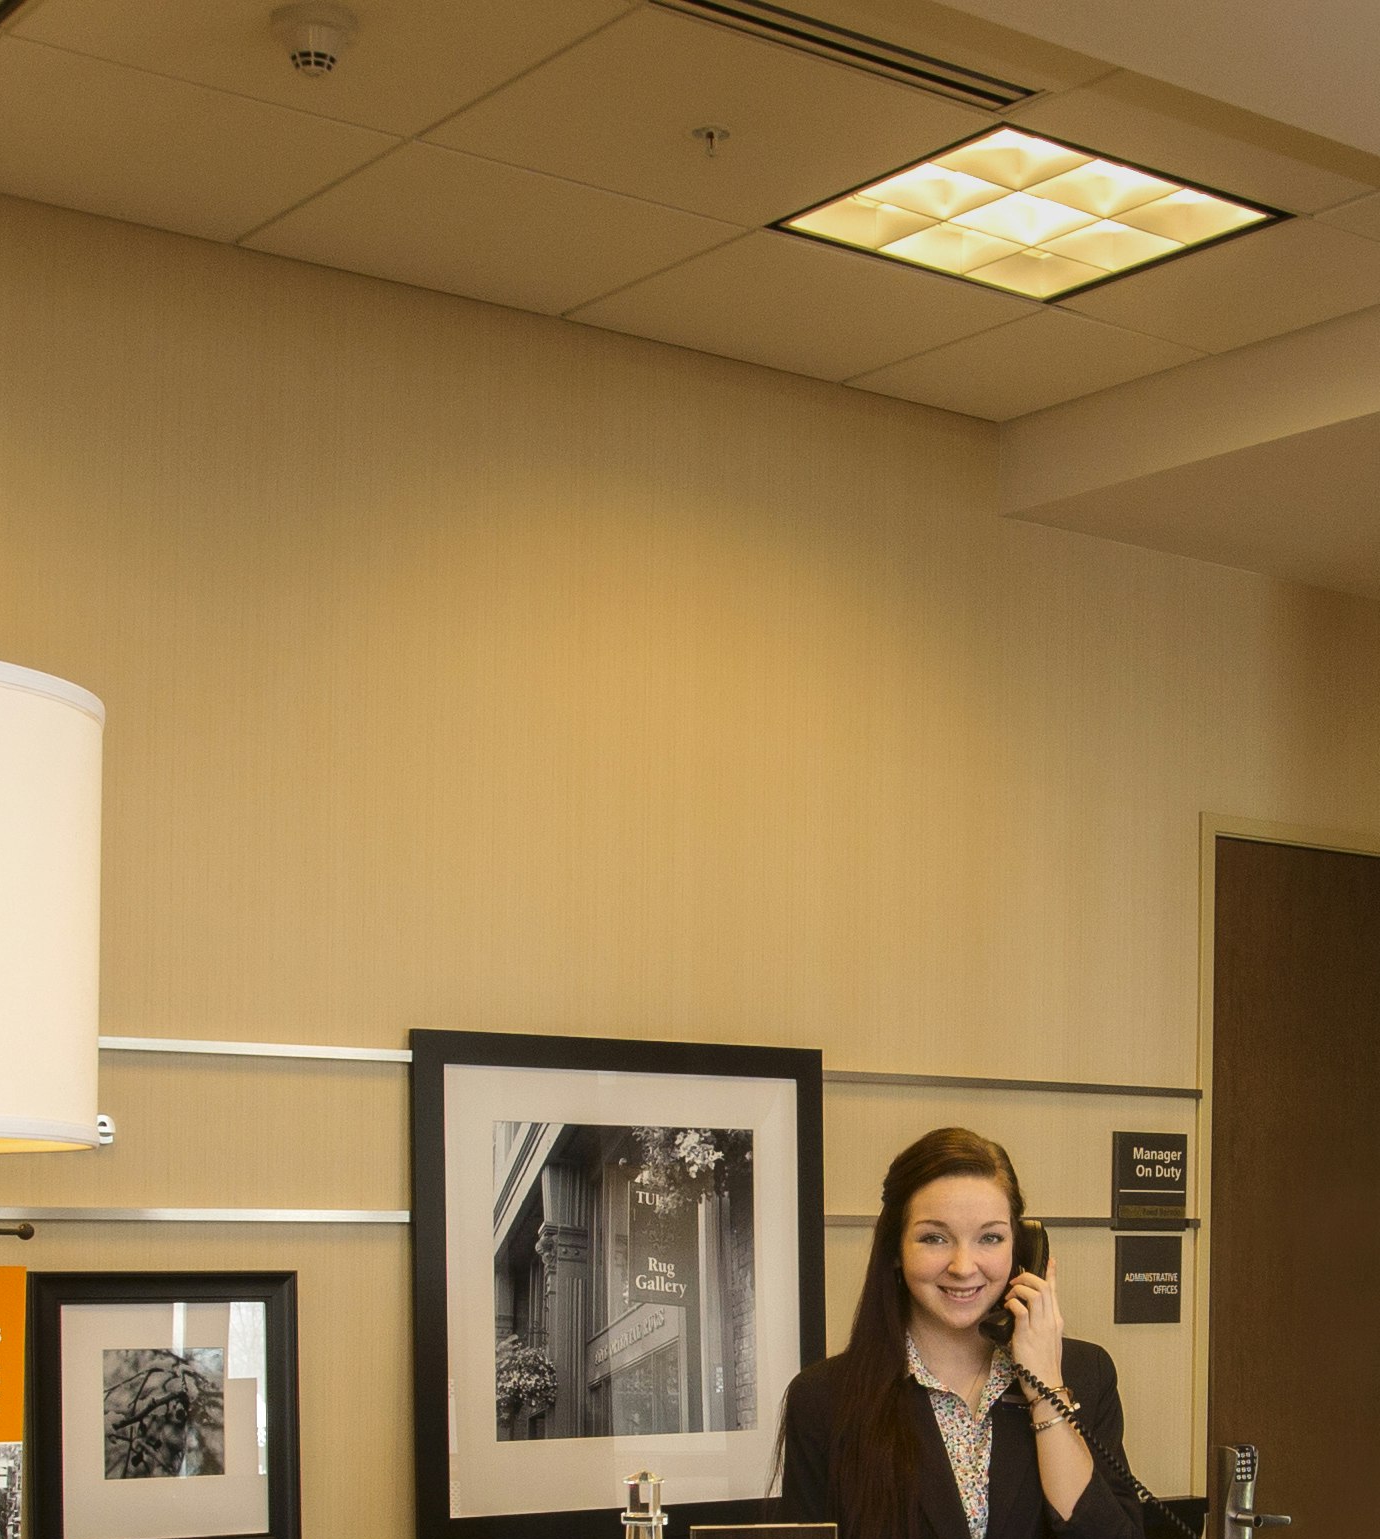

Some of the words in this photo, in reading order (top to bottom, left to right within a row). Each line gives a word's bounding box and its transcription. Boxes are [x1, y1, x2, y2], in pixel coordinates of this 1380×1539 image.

[1133, 1147, 1182, 1164] Manager
[1136, 1165, 1152, 1177] On
[1155, 1165, 1182, 1181] Duty
[648, 1257, 675, 1278] Rug
[1125, 1272, 1178, 1282] ADMINISTRATIVE
[636, 1275, 687, 1298] Gallery
[1153, 1285, 1178, 1294] OFFICES
